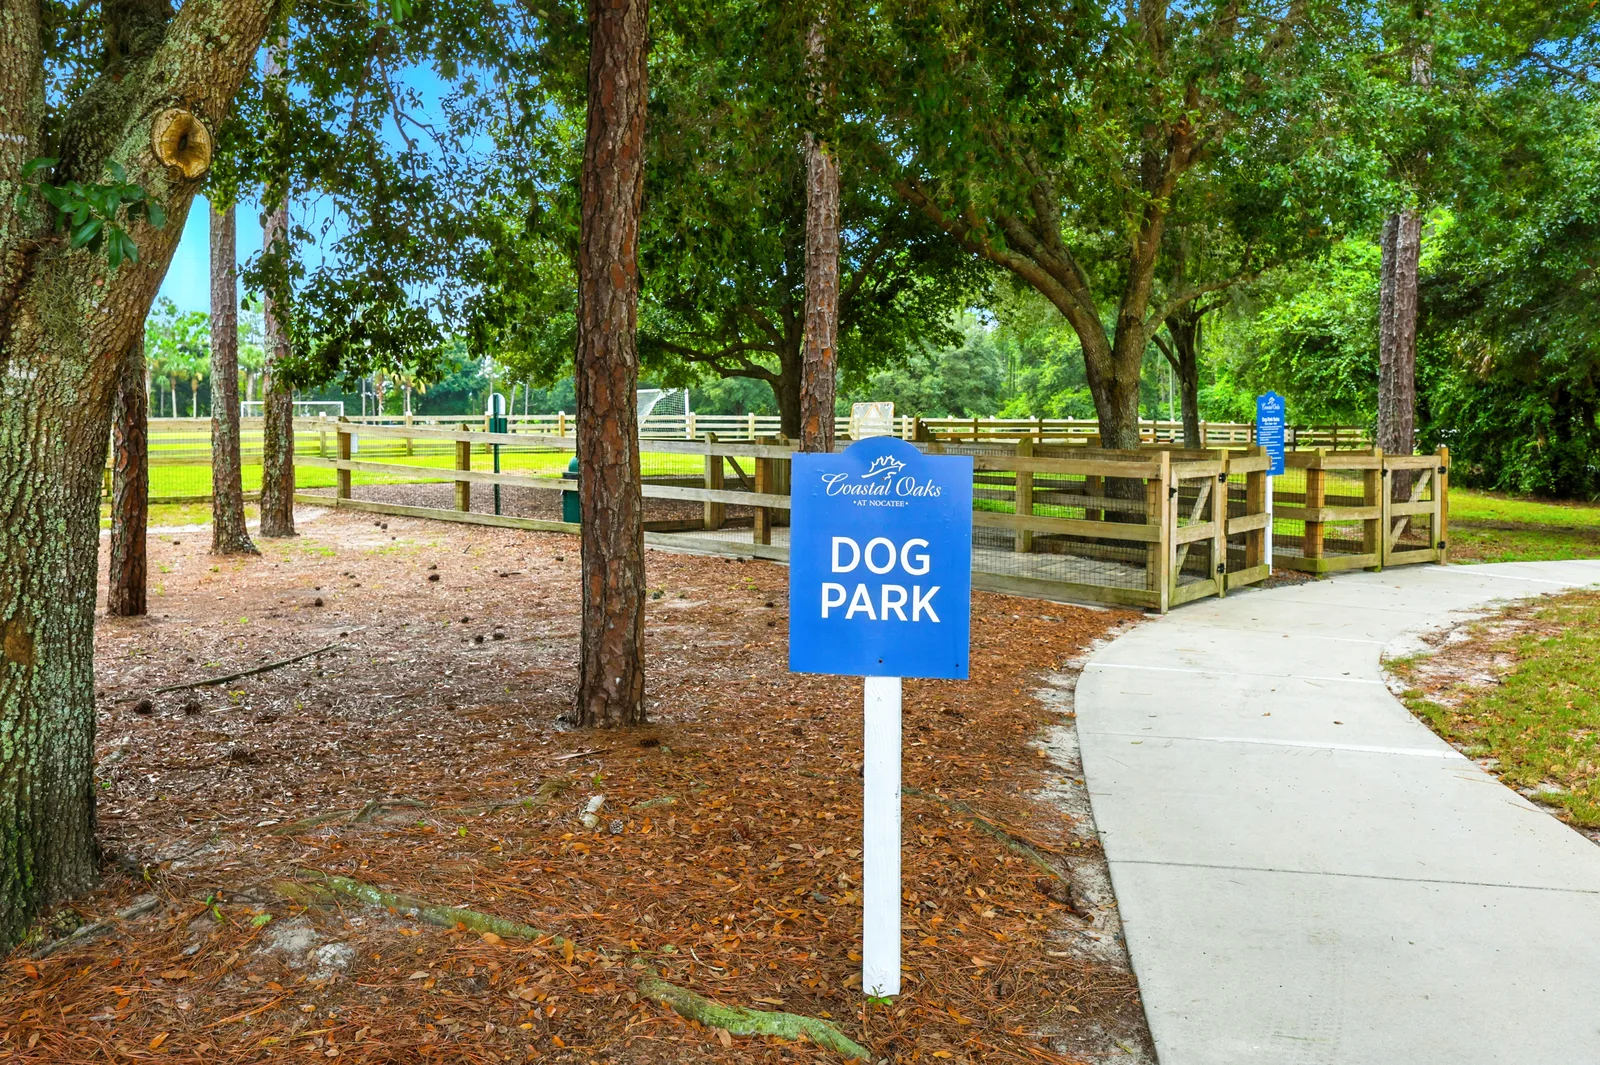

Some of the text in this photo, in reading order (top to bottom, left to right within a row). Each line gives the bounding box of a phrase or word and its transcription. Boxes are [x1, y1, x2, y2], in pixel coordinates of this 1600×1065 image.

[821, 473, 941, 497] Coastal Oaks
[831, 537, 931, 576] DOG
[821, 582, 941, 623] PARK
